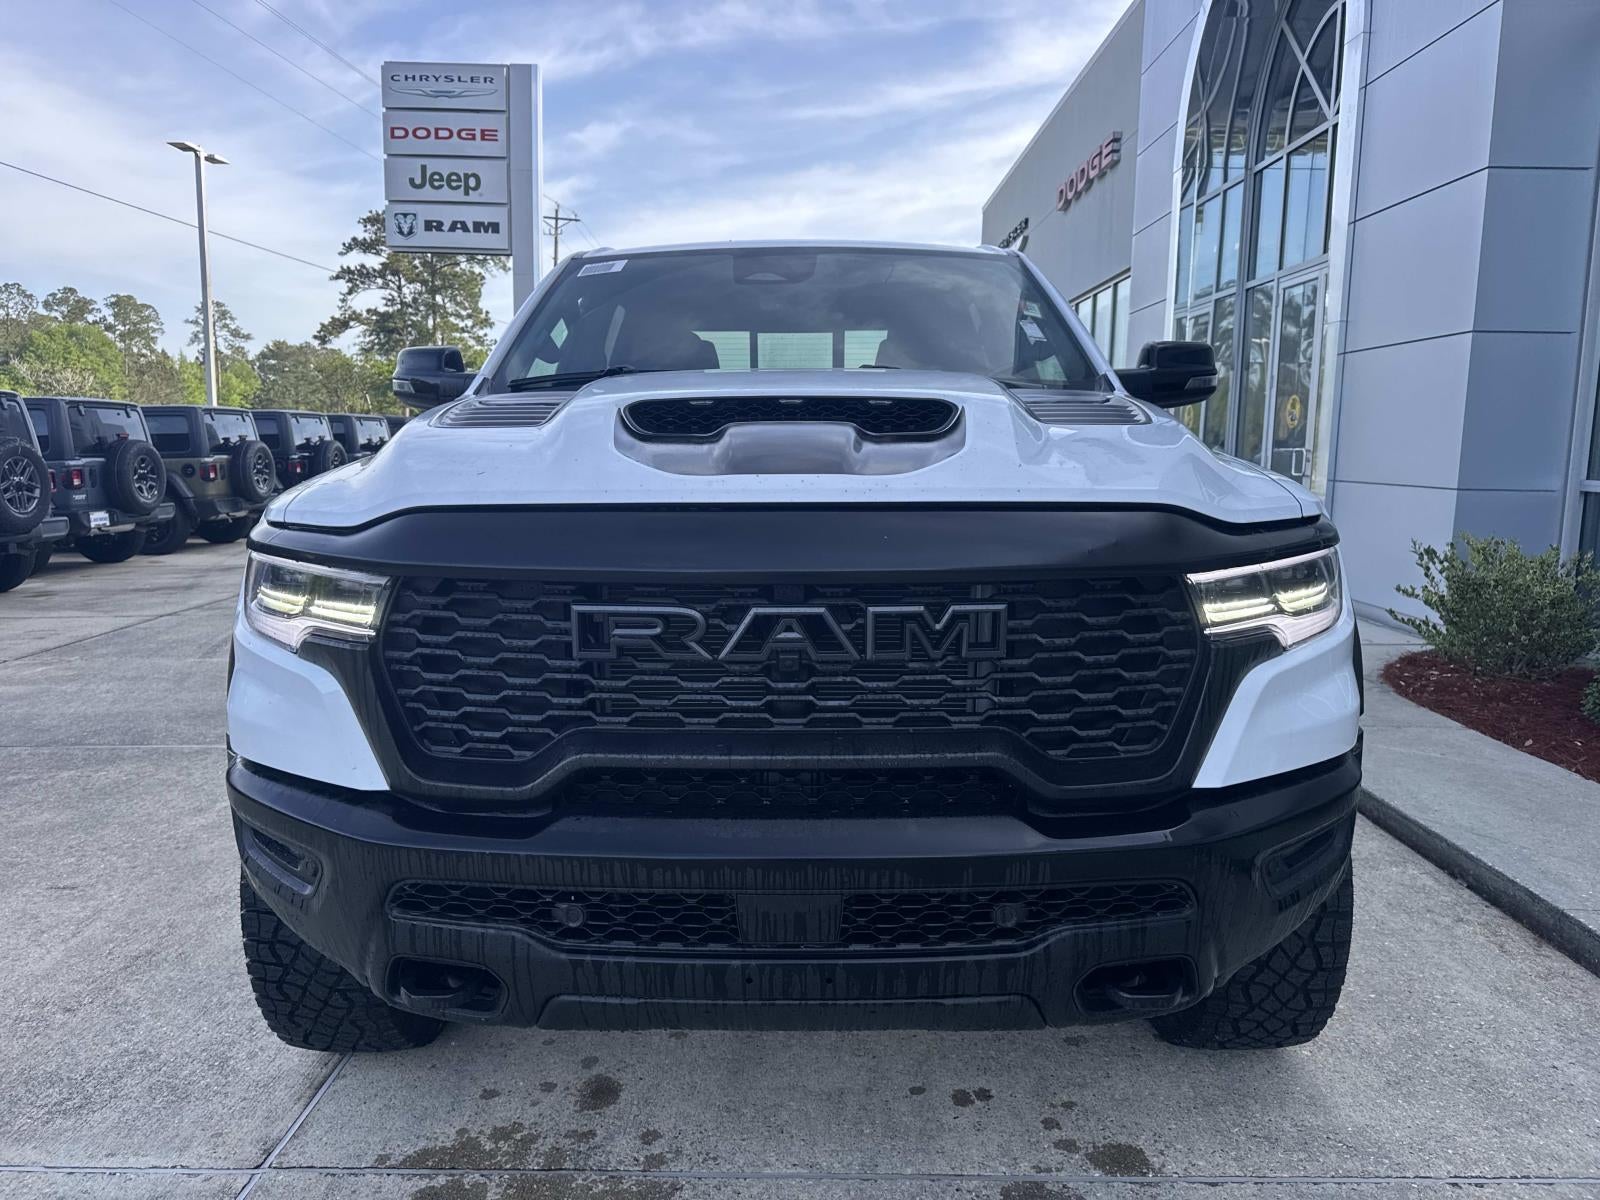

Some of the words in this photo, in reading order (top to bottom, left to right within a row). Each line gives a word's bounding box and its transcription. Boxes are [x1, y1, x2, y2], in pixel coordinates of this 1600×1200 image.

[390, 74, 495, 84] CHRYSLER
[389, 126, 499, 142] DODGE
[408, 164, 482, 196] Jeep
[1056, 131, 1123, 212] DODGE
[423, 219, 500, 234] RAM
[571, 604, 1008, 660] RAM
